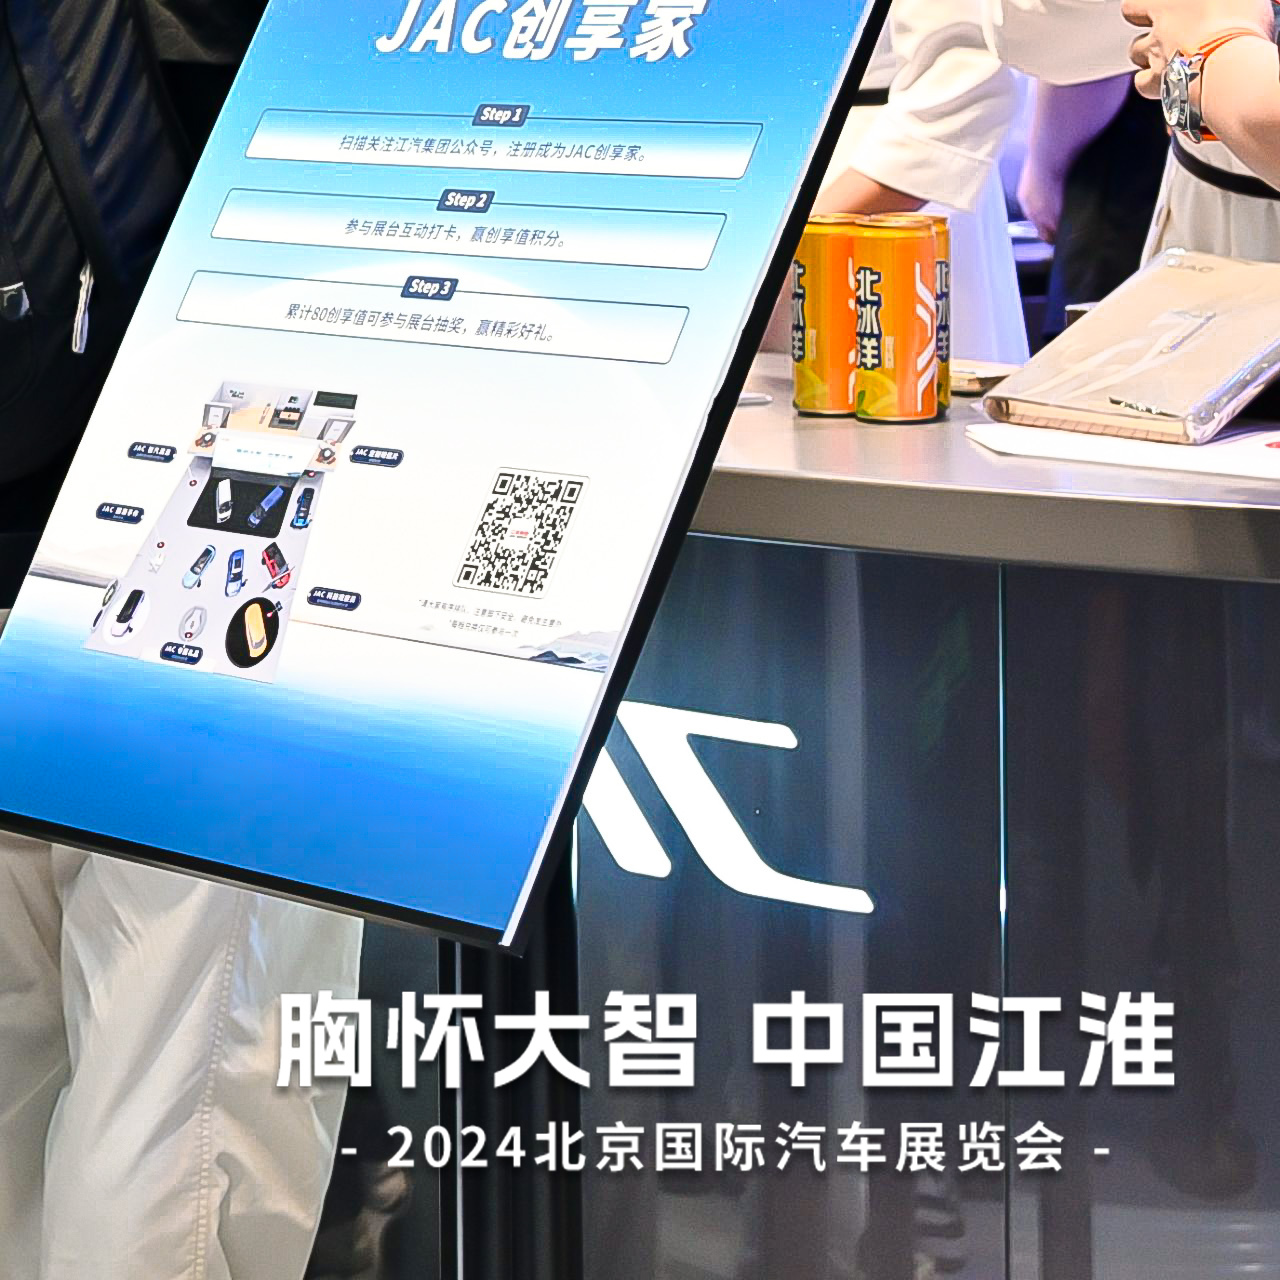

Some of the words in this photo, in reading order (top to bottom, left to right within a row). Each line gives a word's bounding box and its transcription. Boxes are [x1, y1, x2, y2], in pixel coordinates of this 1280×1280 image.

[481, 107, 511, 124] Step
[512, 109, 522, 121] 1
[445, 192, 475, 209] Step
[476, 193, 487, 207] 2
[345, 218, 565, 248] 参与展台互动打卡，赢创享值积分。
[409, 279, 438, 297] Step
[440, 281, 451, 295] 3
[285, 303, 553, 342] 累计80创享值可参与展台抽奖，赢精彩好礼。
[855, 268, 880, 369] 北冰洋
